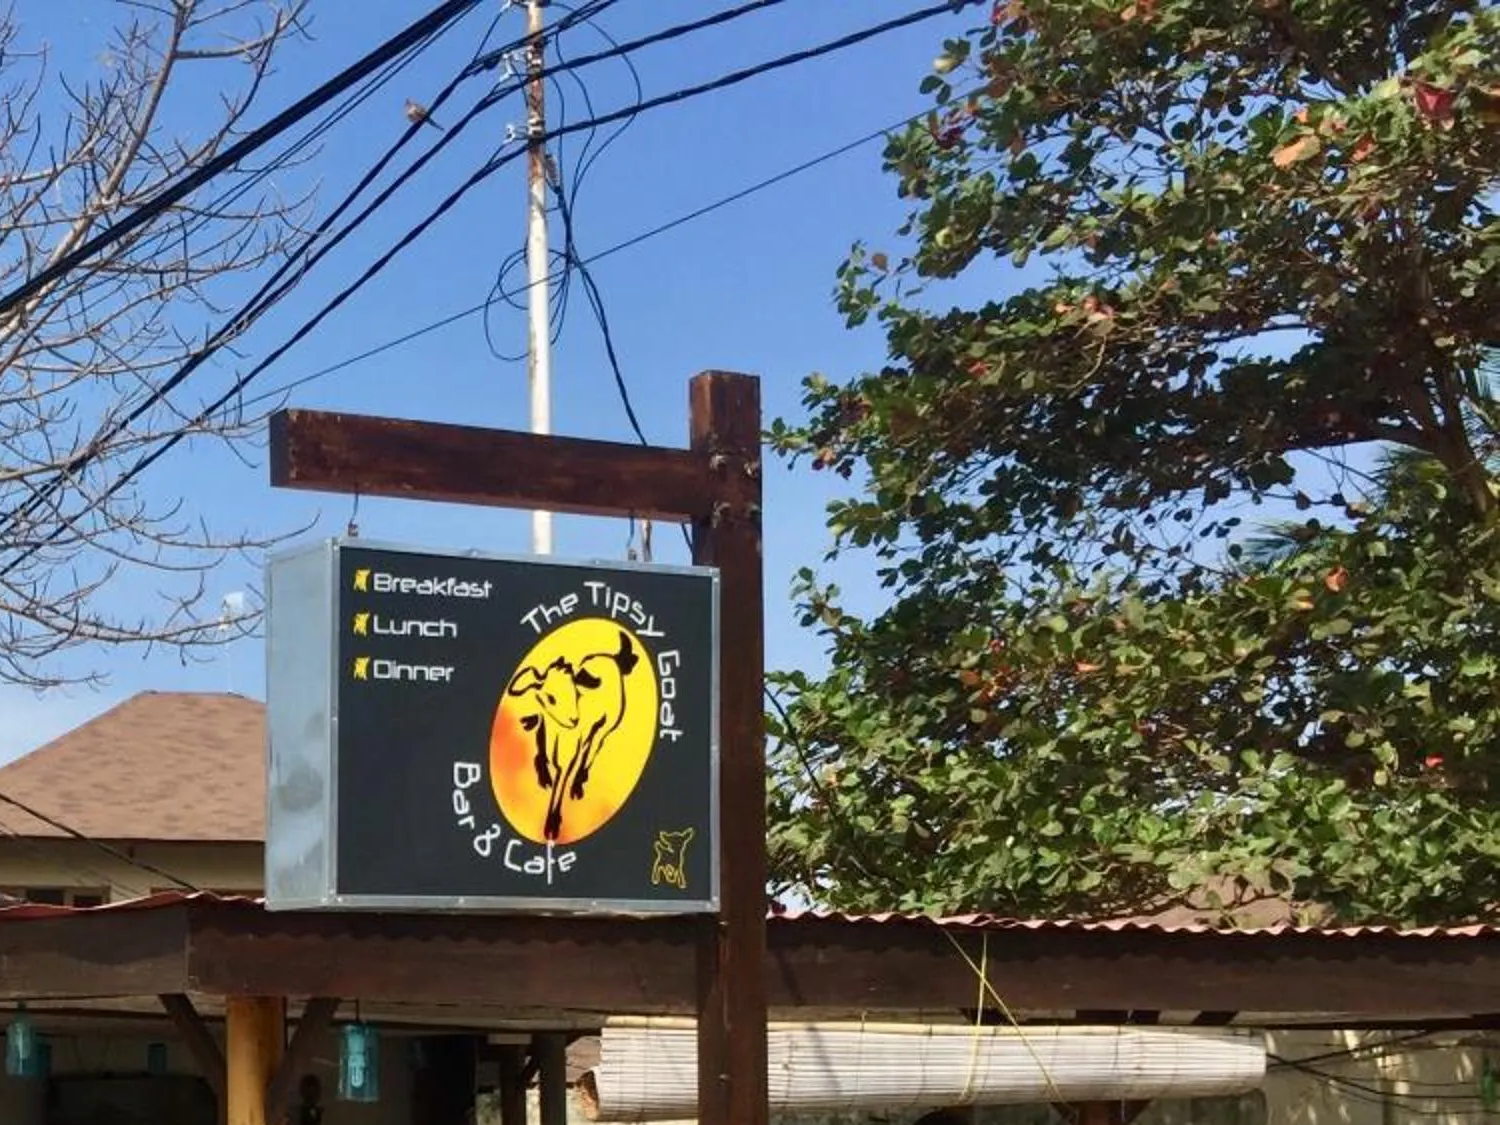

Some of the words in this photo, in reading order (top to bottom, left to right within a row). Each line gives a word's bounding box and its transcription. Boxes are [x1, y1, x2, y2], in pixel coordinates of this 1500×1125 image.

[373, 572, 492, 599] Breakfast
[373, 615, 458, 639] Lunch
[373, 661, 455, 683] Dinner
[520, 592, 579, 634] The
[584, 581, 665, 639] Tipsy
[657, 649, 684, 742] Goat
[452, 761, 481, 830] Bar
[473, 823, 501, 857] &
[504, 833, 578, 884] Cafe
